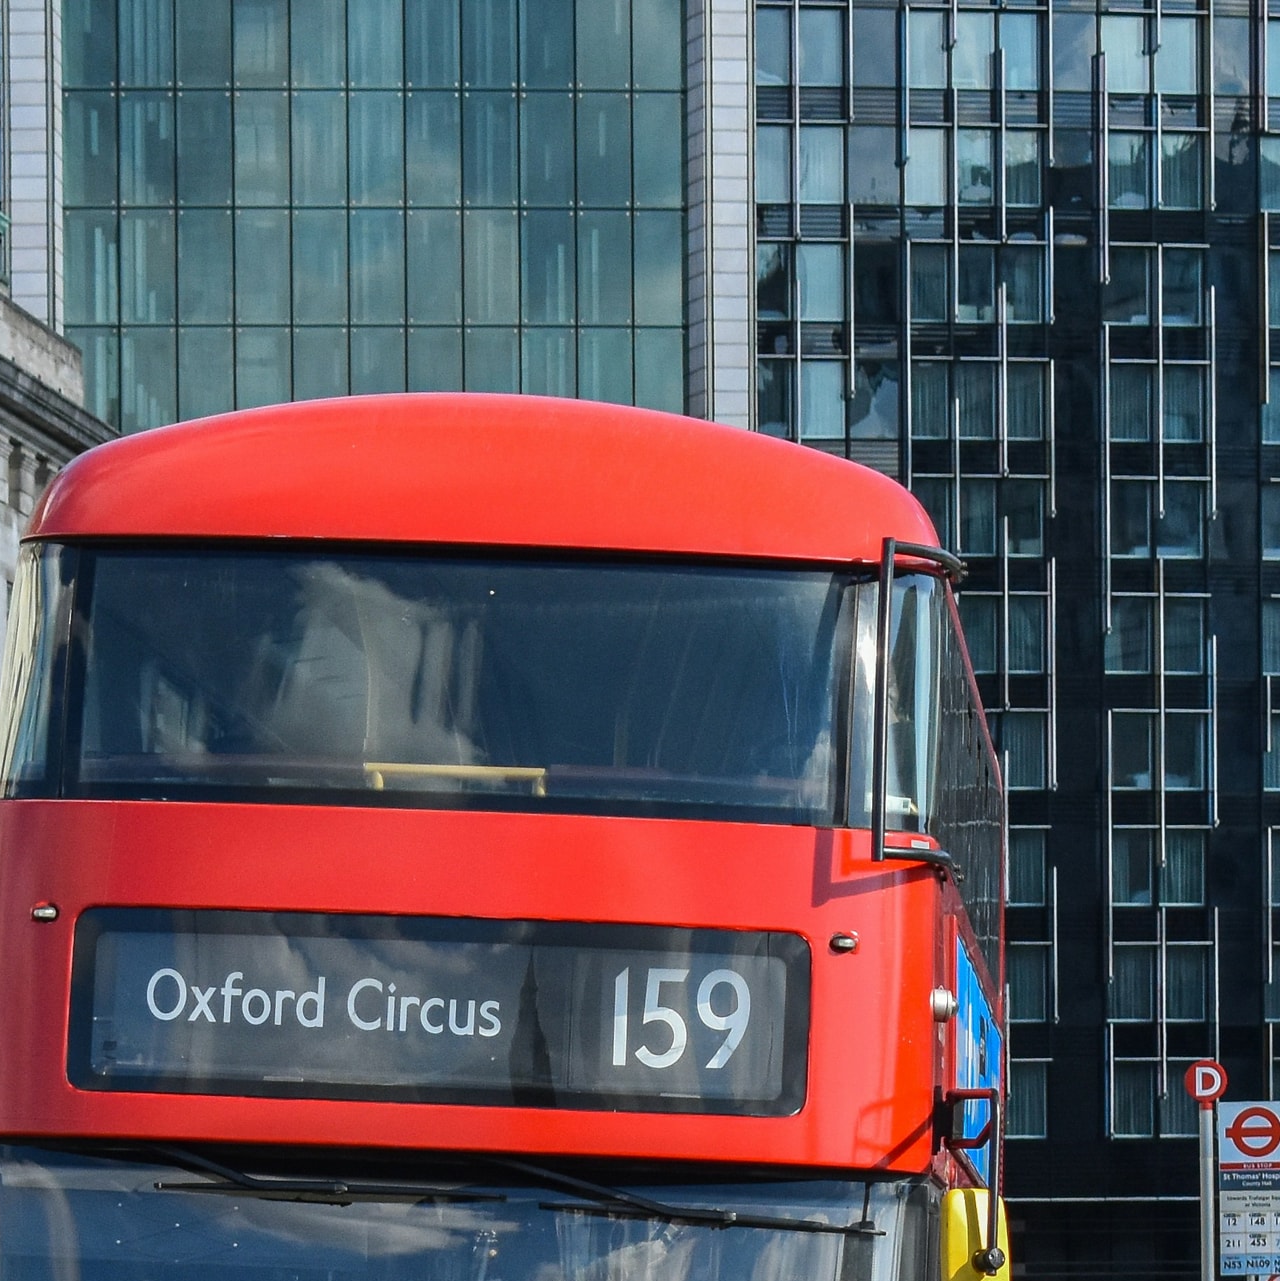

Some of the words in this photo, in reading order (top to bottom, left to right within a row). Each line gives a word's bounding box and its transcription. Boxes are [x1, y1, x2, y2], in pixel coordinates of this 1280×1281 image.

[146, 967, 326, 1028] Oxford
[347, 978, 502, 1037] Circus
[612, 966, 751, 1069] 159
[1195, 1066, 1221, 1097] D
[1223, 1173, 1231, 1181] St
[1227, 1217, 1238, 1226] 12
[1250, 1217, 1266, 1226] 148
[1225, 1239, 1242, 1248] 211
[1223, 1261, 1243, 1270] N53
[1246, 1260, 1271, 1268] N109
